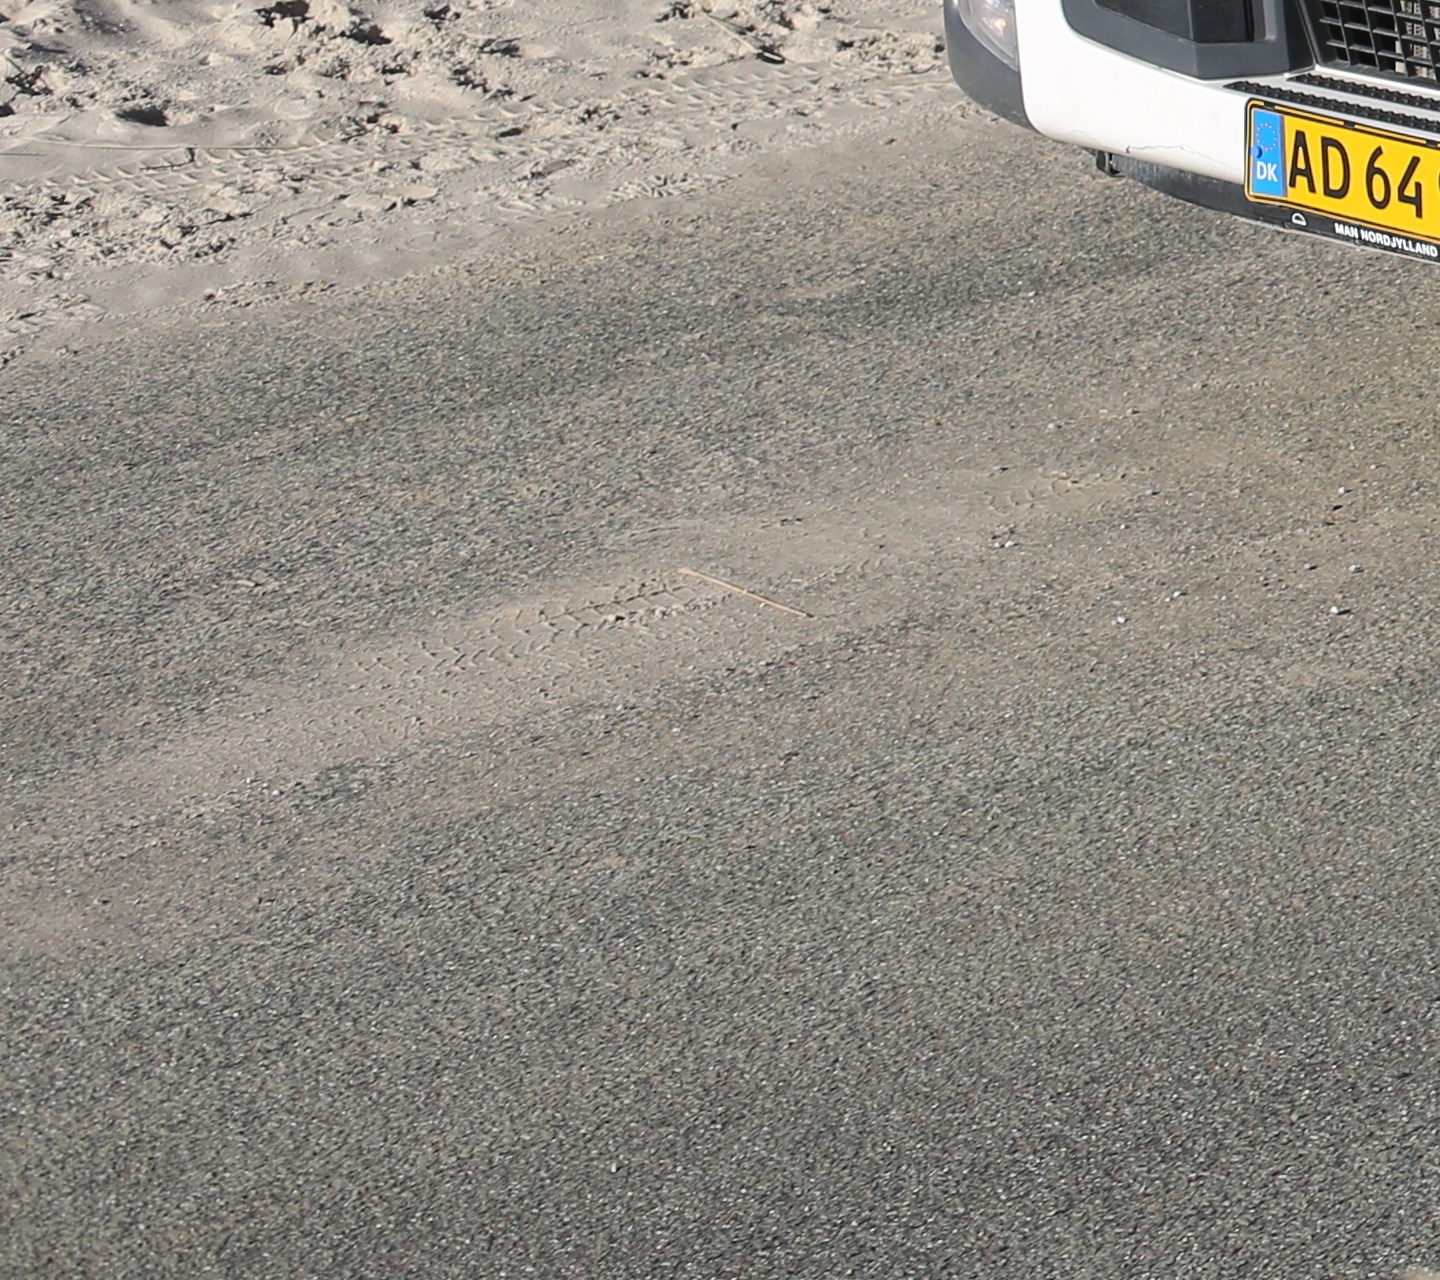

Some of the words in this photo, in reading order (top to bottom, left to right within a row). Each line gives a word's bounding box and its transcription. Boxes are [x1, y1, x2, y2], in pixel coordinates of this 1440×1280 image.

[1256, 160, 1278, 182] DK
[1288, 129, 1351, 199] AD
[1366, 145, 1423, 219] 64
[1334, 223, 1358, 239] MAN
[1360, 230, 1438, 258] NORDJYLLAND
